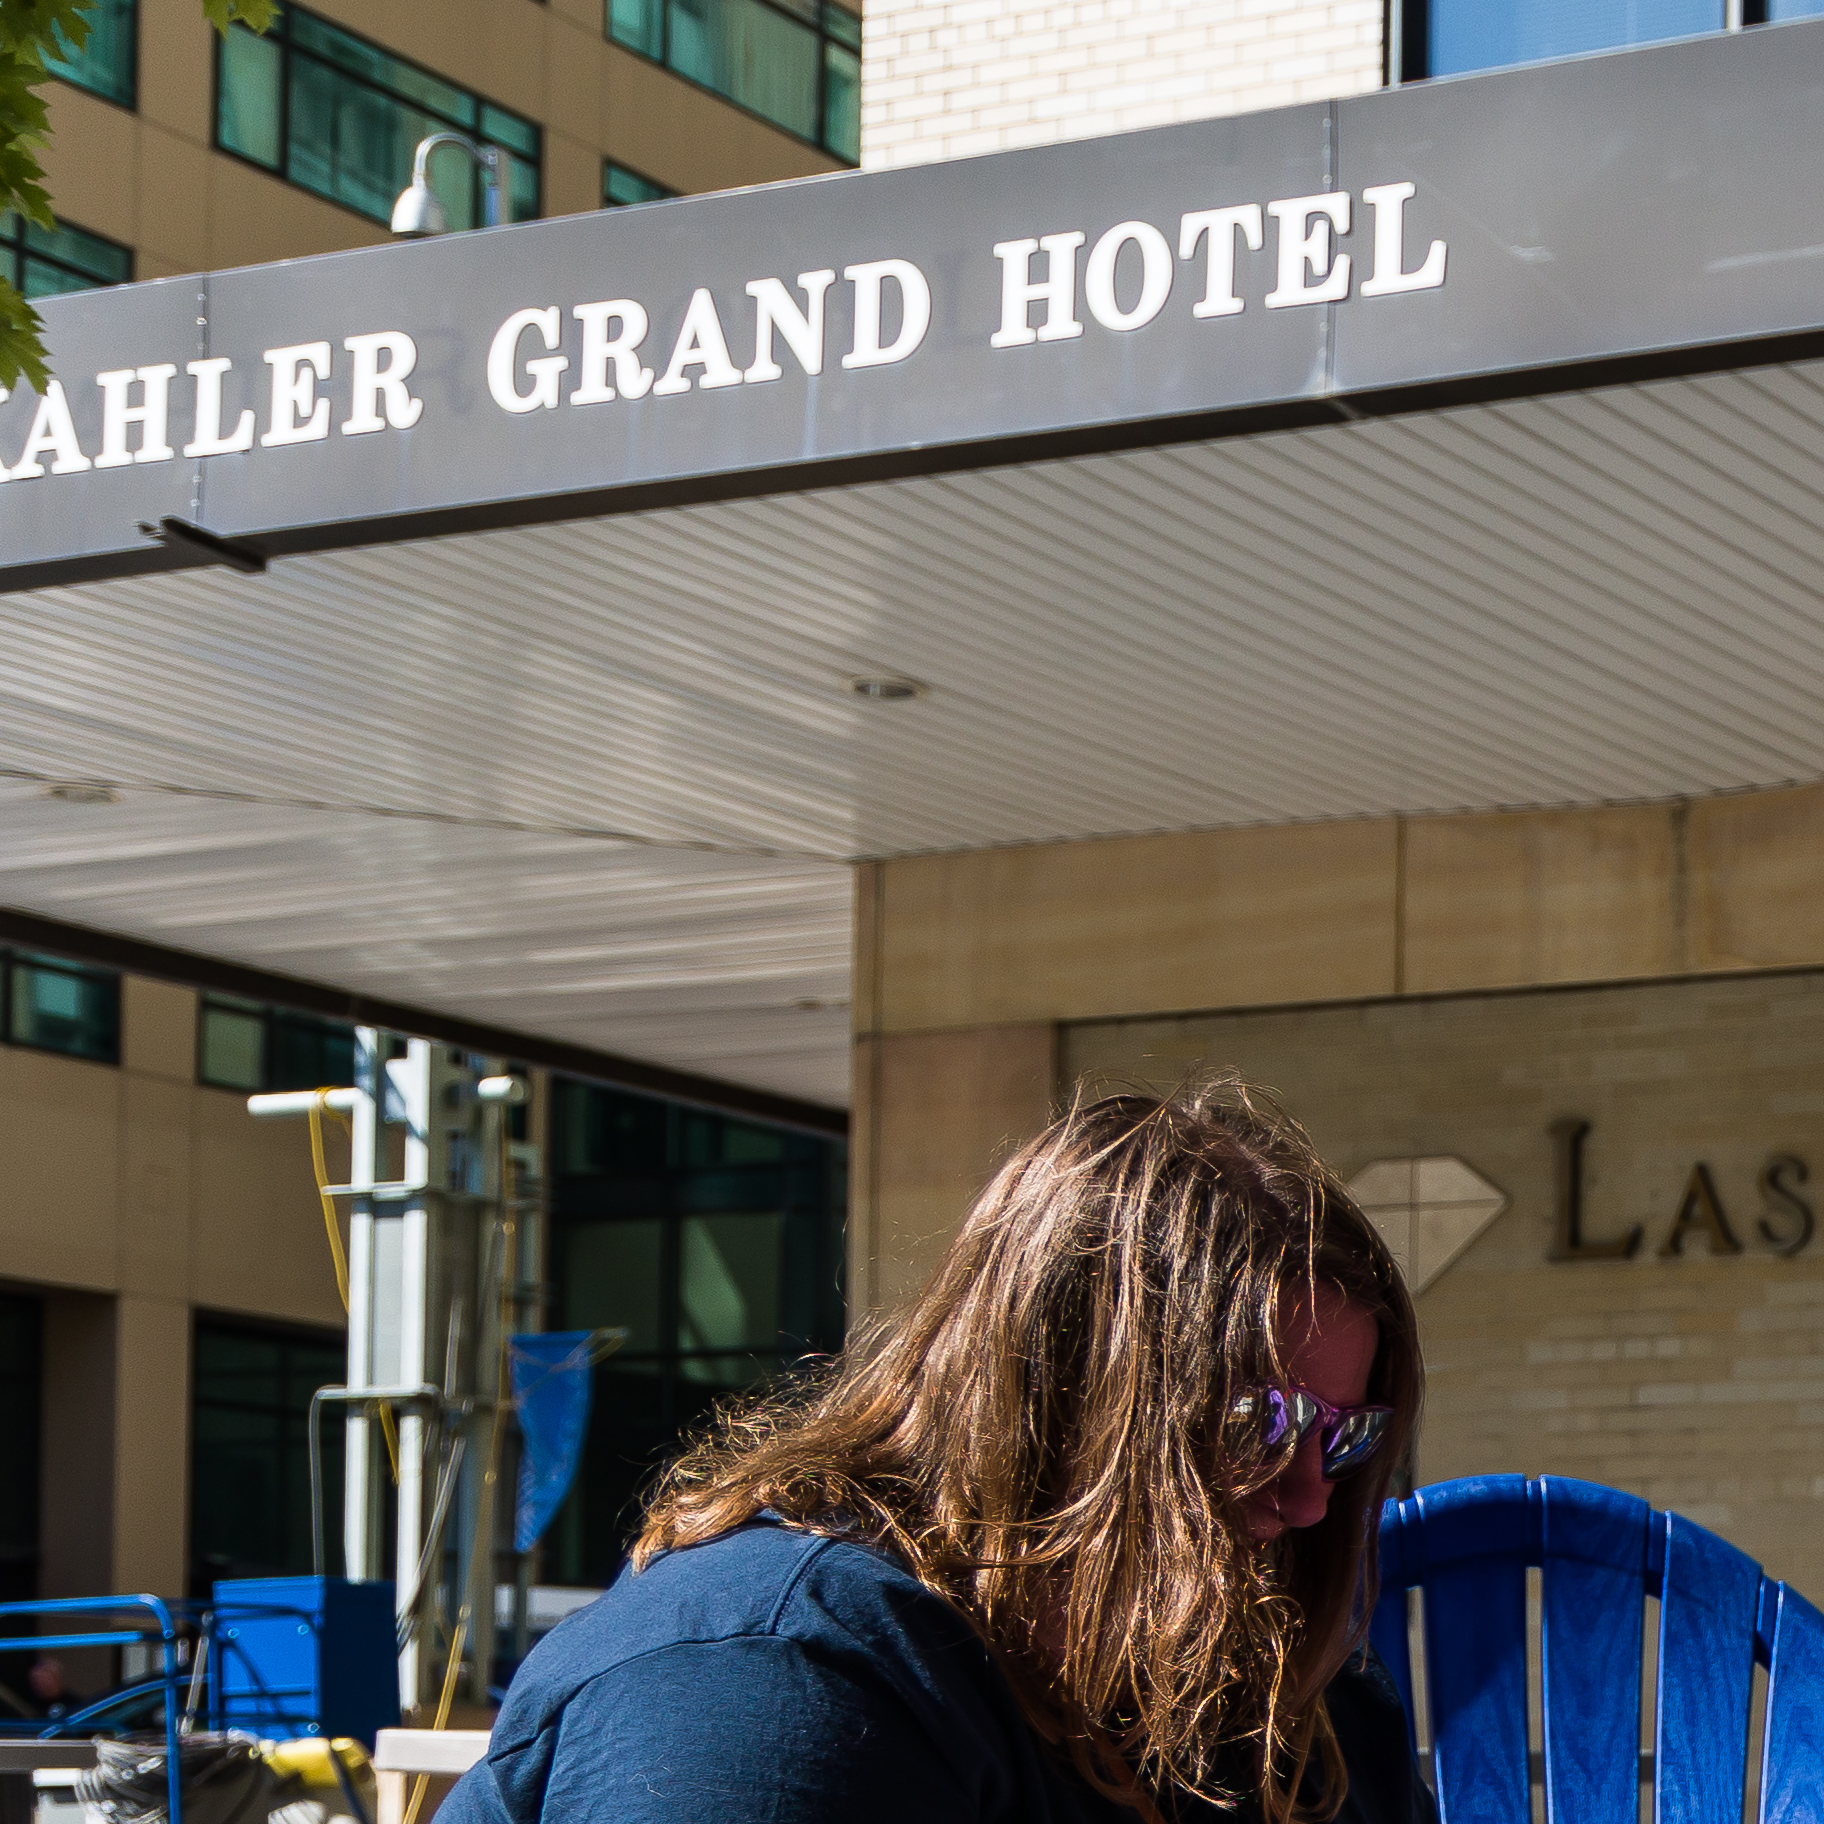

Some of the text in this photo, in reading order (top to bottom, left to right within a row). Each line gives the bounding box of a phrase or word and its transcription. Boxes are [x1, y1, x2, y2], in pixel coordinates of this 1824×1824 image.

[0, 181, 1448, 482] AHLER GRAND HOTEL
